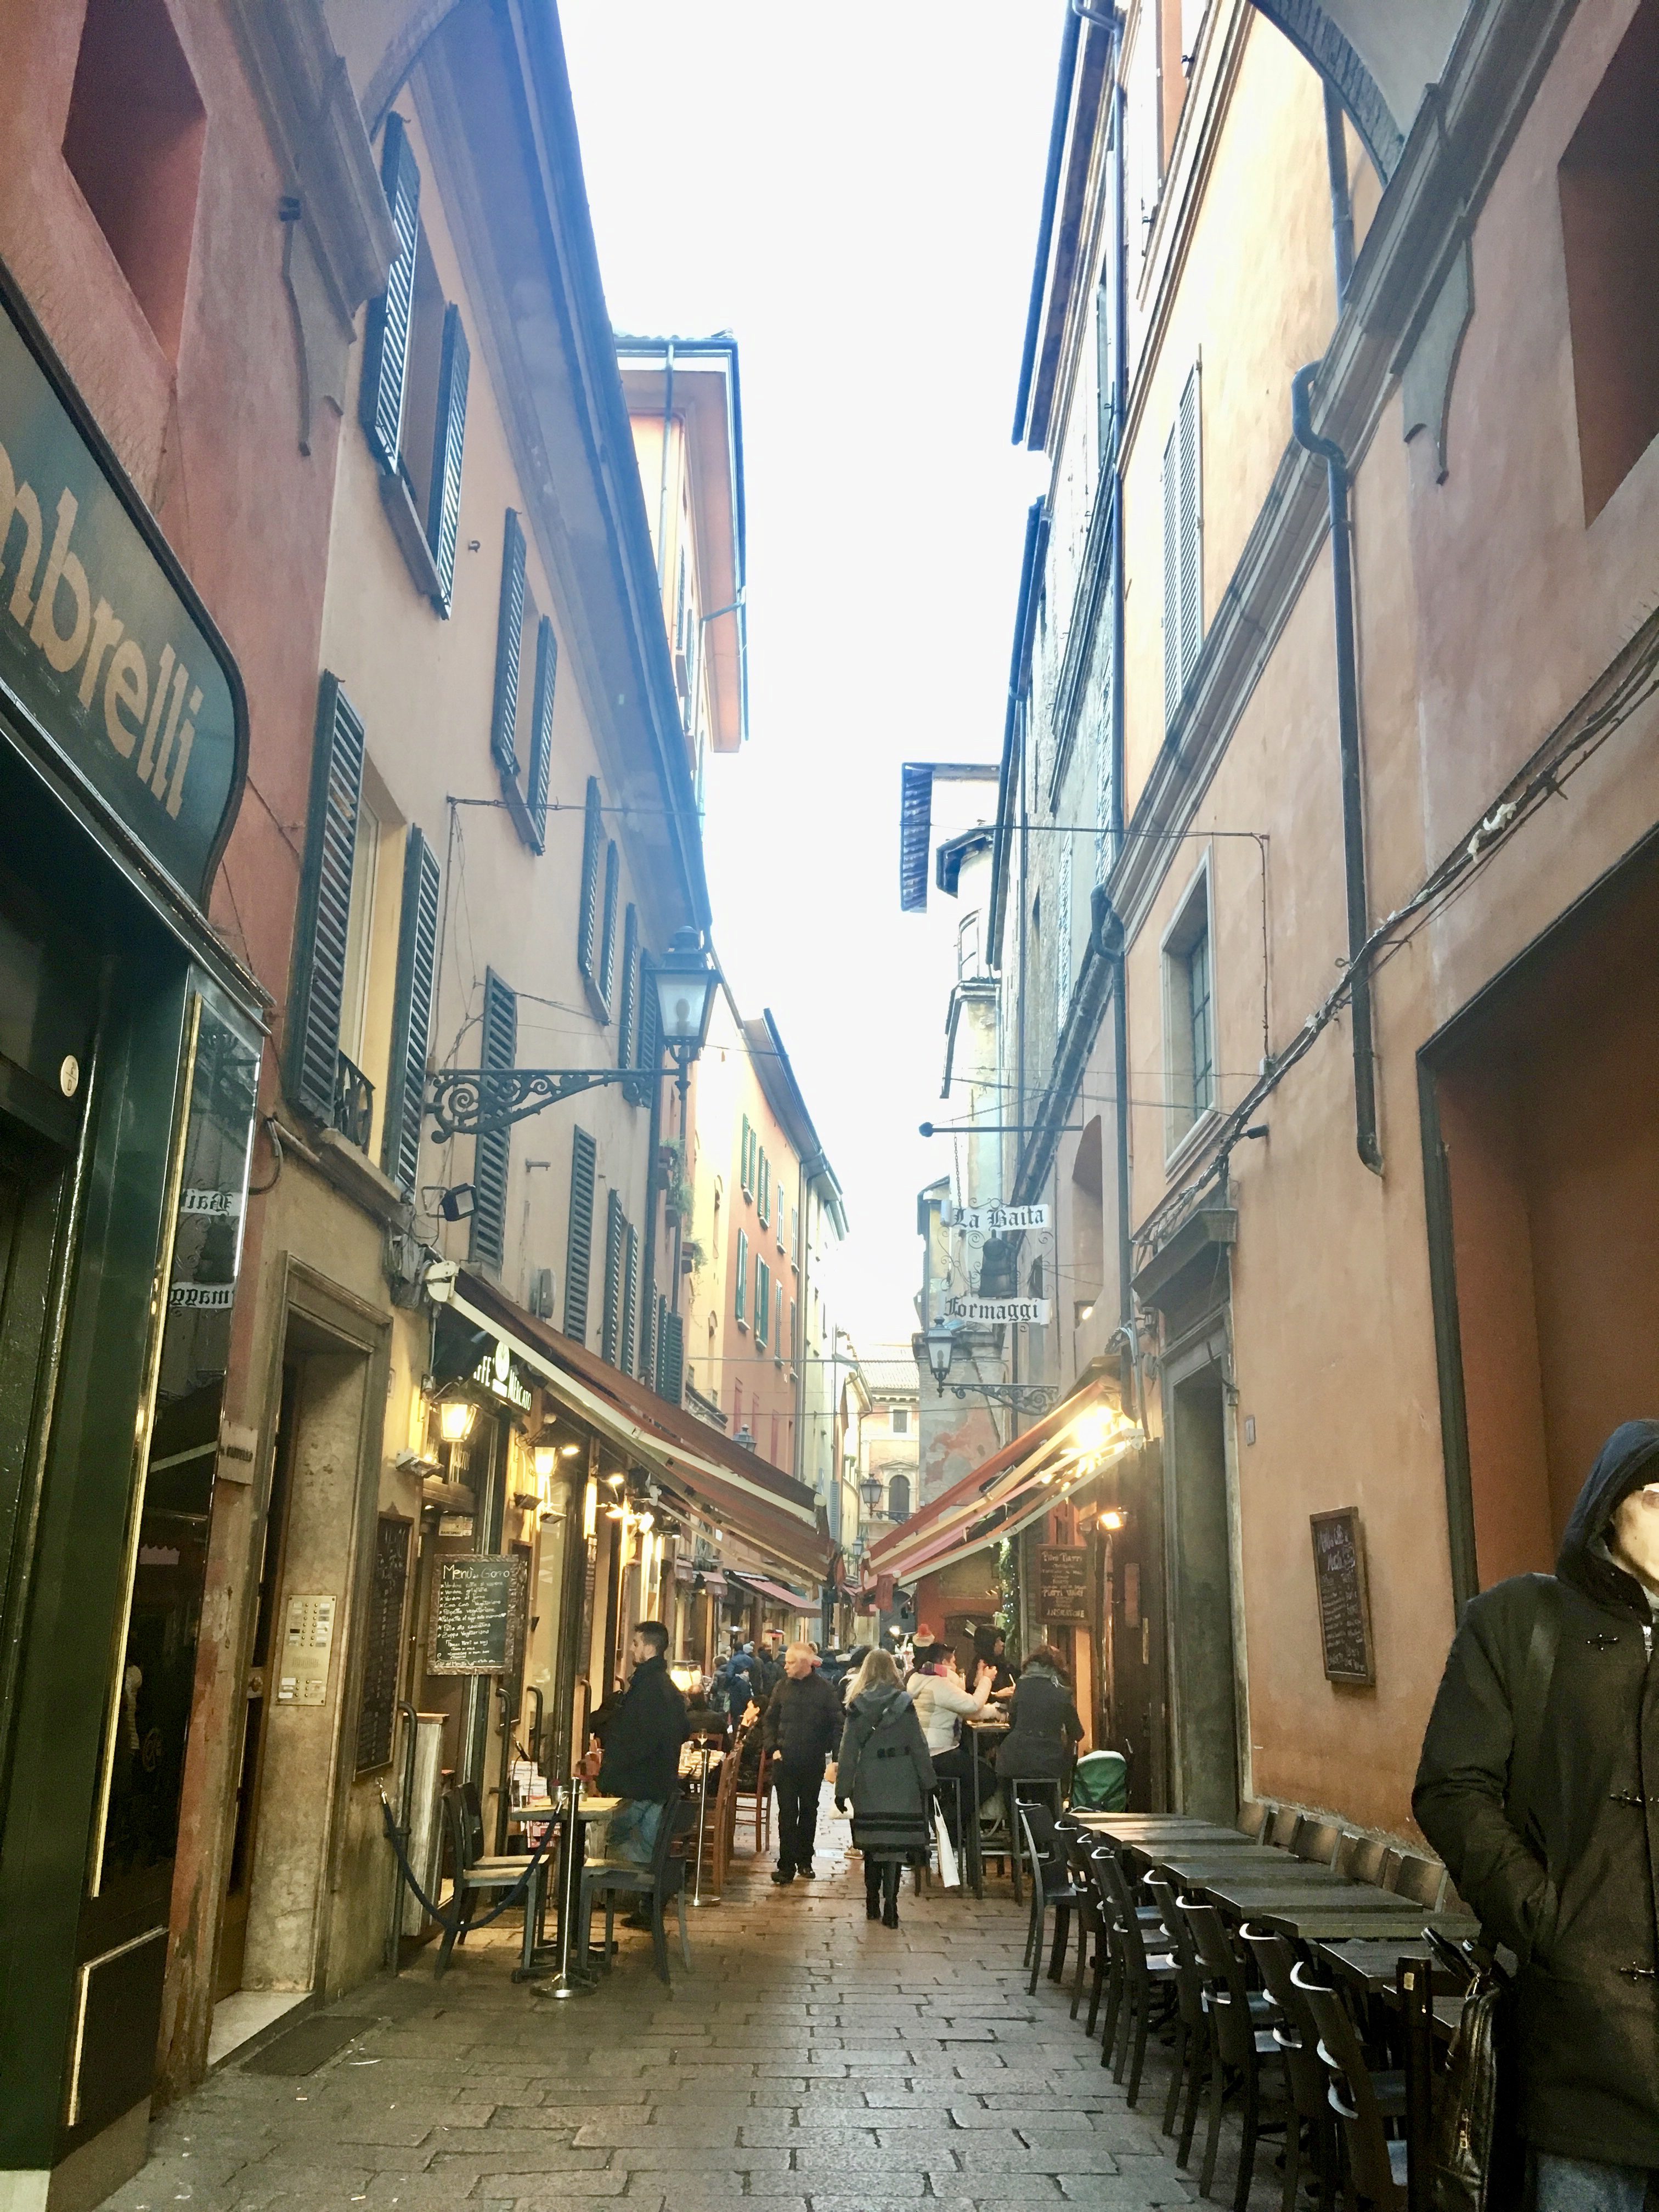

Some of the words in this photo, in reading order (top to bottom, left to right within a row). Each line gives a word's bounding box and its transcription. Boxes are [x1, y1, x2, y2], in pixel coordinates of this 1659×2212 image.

[952, 1207, 979, 1228] La
[987, 1206, 1045, 1231] Baita
[943, 1295, 1039, 1322] Formaggi
[507, 1369, 532, 1411] MERCATO
[443, 1564, 473, 1580] Menù
